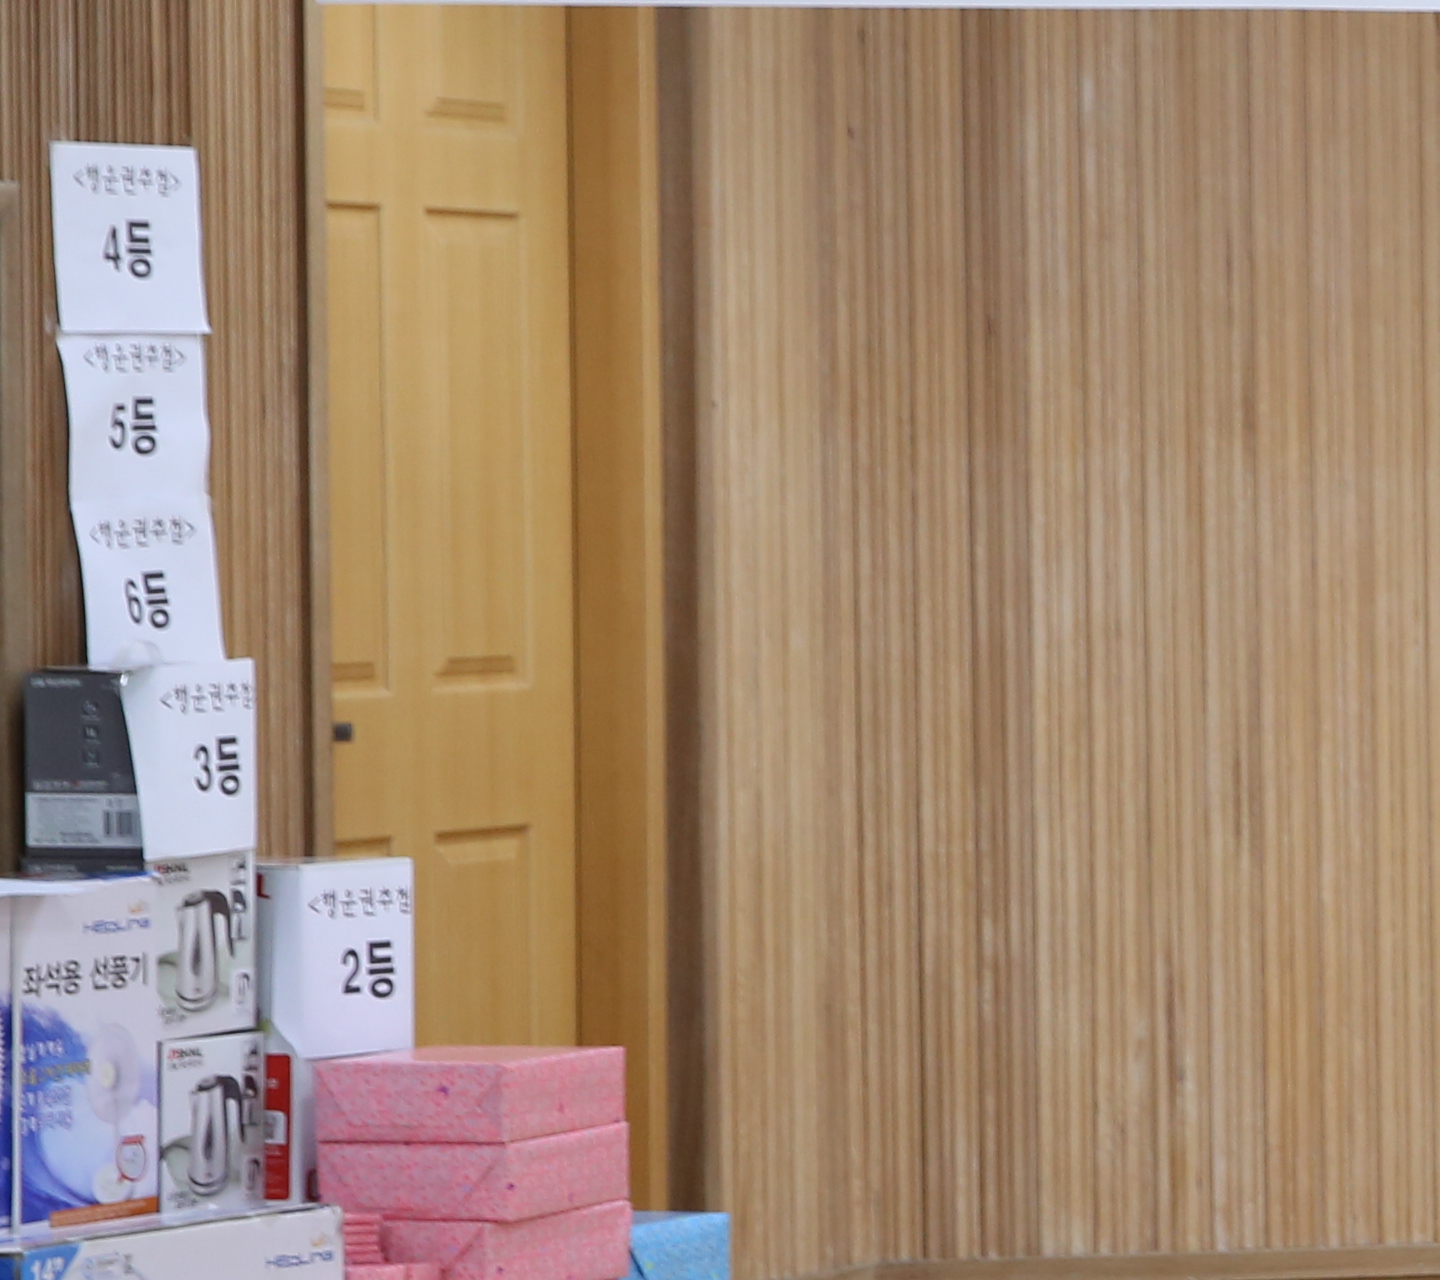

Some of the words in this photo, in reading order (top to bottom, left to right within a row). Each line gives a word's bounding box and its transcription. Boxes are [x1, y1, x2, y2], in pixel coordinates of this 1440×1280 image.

[102, 219, 152, 279] 4등
[109, 397, 156, 455] 5등
[124, 570, 170, 629] 6등
[193, 736, 241, 796] 3등
[90, 951, 148, 992] 선풍기
[342, 940, 394, 999] 2등
